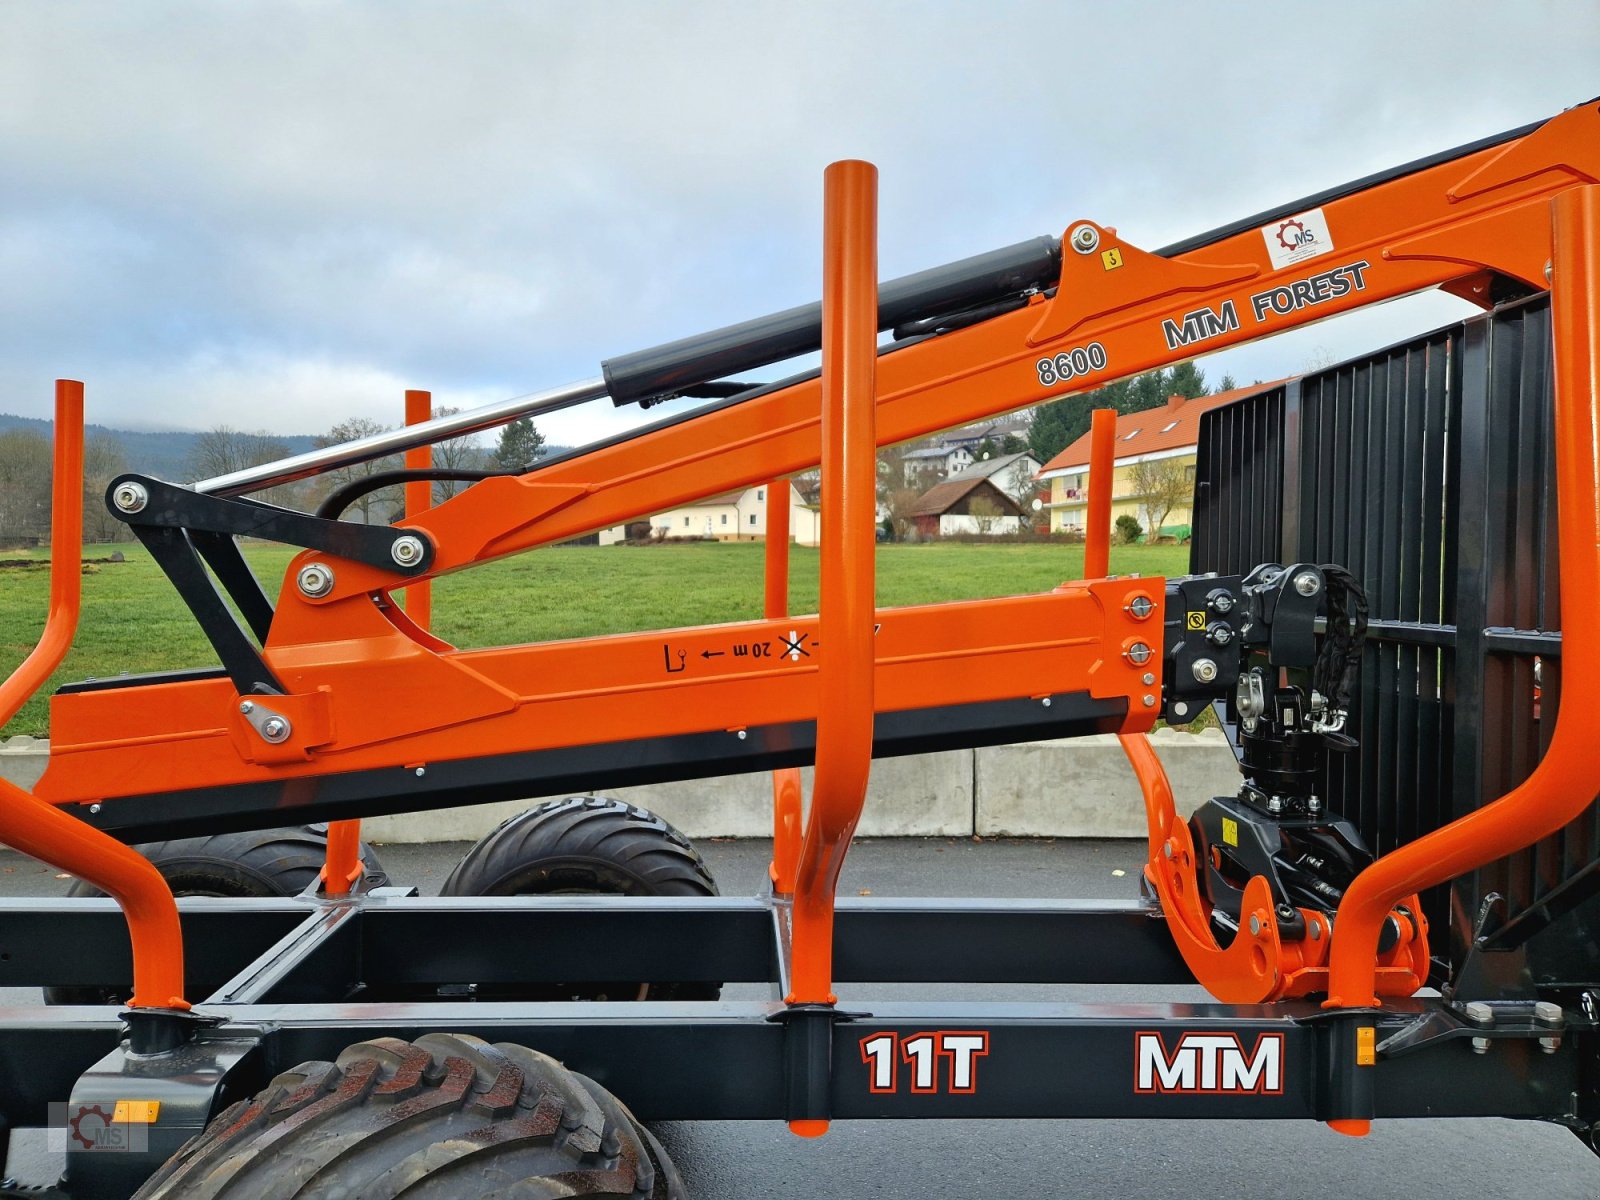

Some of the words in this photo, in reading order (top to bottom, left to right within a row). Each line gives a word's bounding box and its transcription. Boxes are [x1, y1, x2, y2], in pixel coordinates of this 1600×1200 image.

[1294, 229, 1315, 246] MS
[1163, 300, 1240, 350] MTM
[1251, 260, 1370, 321] FOREST
[1036, 342, 1107, 386] 8600
[733, 644, 748, 656] m
[752, 642, 771, 657] 20
[860, 1030, 990, 1094] 11T
[1134, 1031, 1285, 1094] MTM
